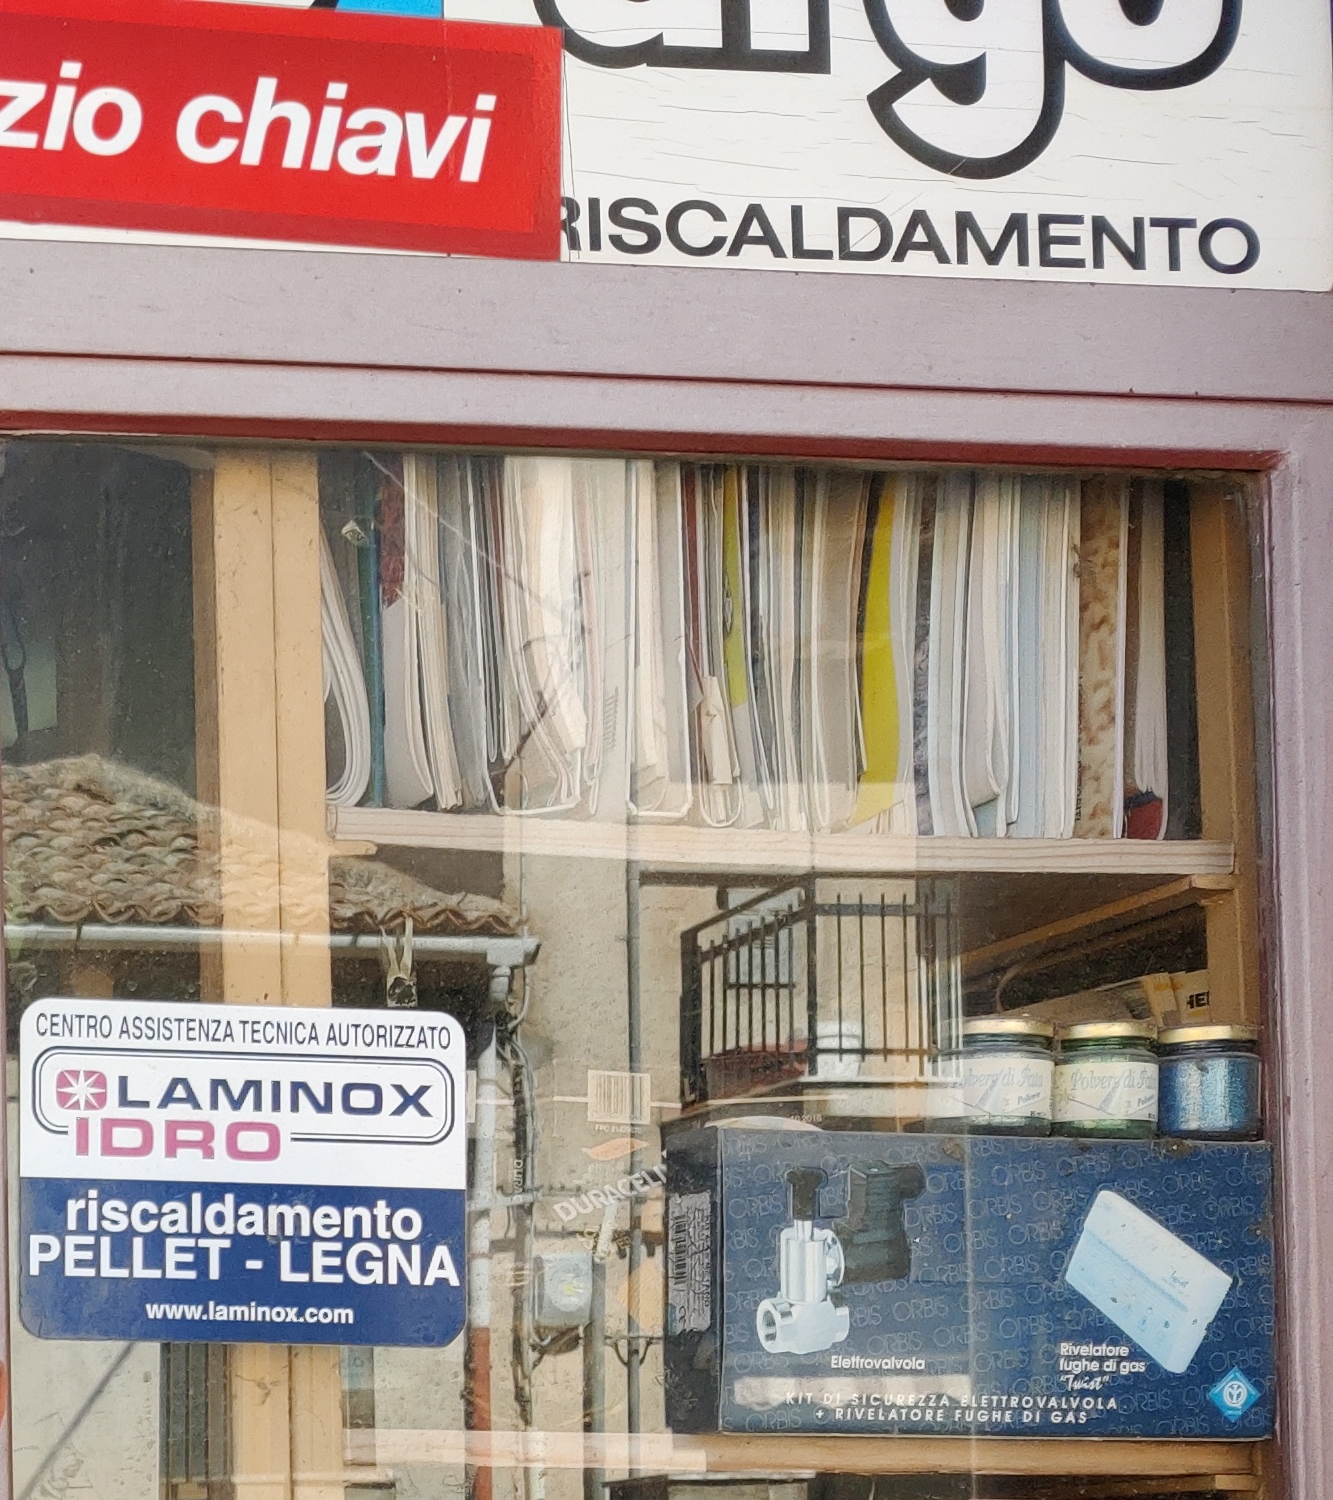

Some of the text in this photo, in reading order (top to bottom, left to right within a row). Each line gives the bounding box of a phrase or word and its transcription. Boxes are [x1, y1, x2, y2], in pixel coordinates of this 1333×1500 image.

[176, 77, 496, 183] chiavi
[35, 1013, 451, 1050] CENTRO ASSISTENZA TECNICA AUTORIZZATO
[117, 1074, 435, 1118] LAMINOX
[74, 1116, 282, 1162] IDRO
[66, 1190, 422, 1241] riscaldamento
[28, 1233, 231, 1280] PELLET
[279, 1241, 460, 1288] LEGNA
[145, 1300, 354, 1325] www.laminox.com
[831, 1355, 926, 1370] Elettrovalvola
[1060, 1342, 1129, 1357] Rivelatore
[1059, 1359, 1146, 1374] fughe di gas
[786, 1392, 1117, 1410] KIT DI SICUREZZA ELETTROVALVOLA
[835, 1408, 944, 1421] RIVELATORE
[955, 1409, 1012, 1422] FUGHE
[1023, 1410, 1040, 1422] DI
[1051, 1411, 1087, 1423] GAS
